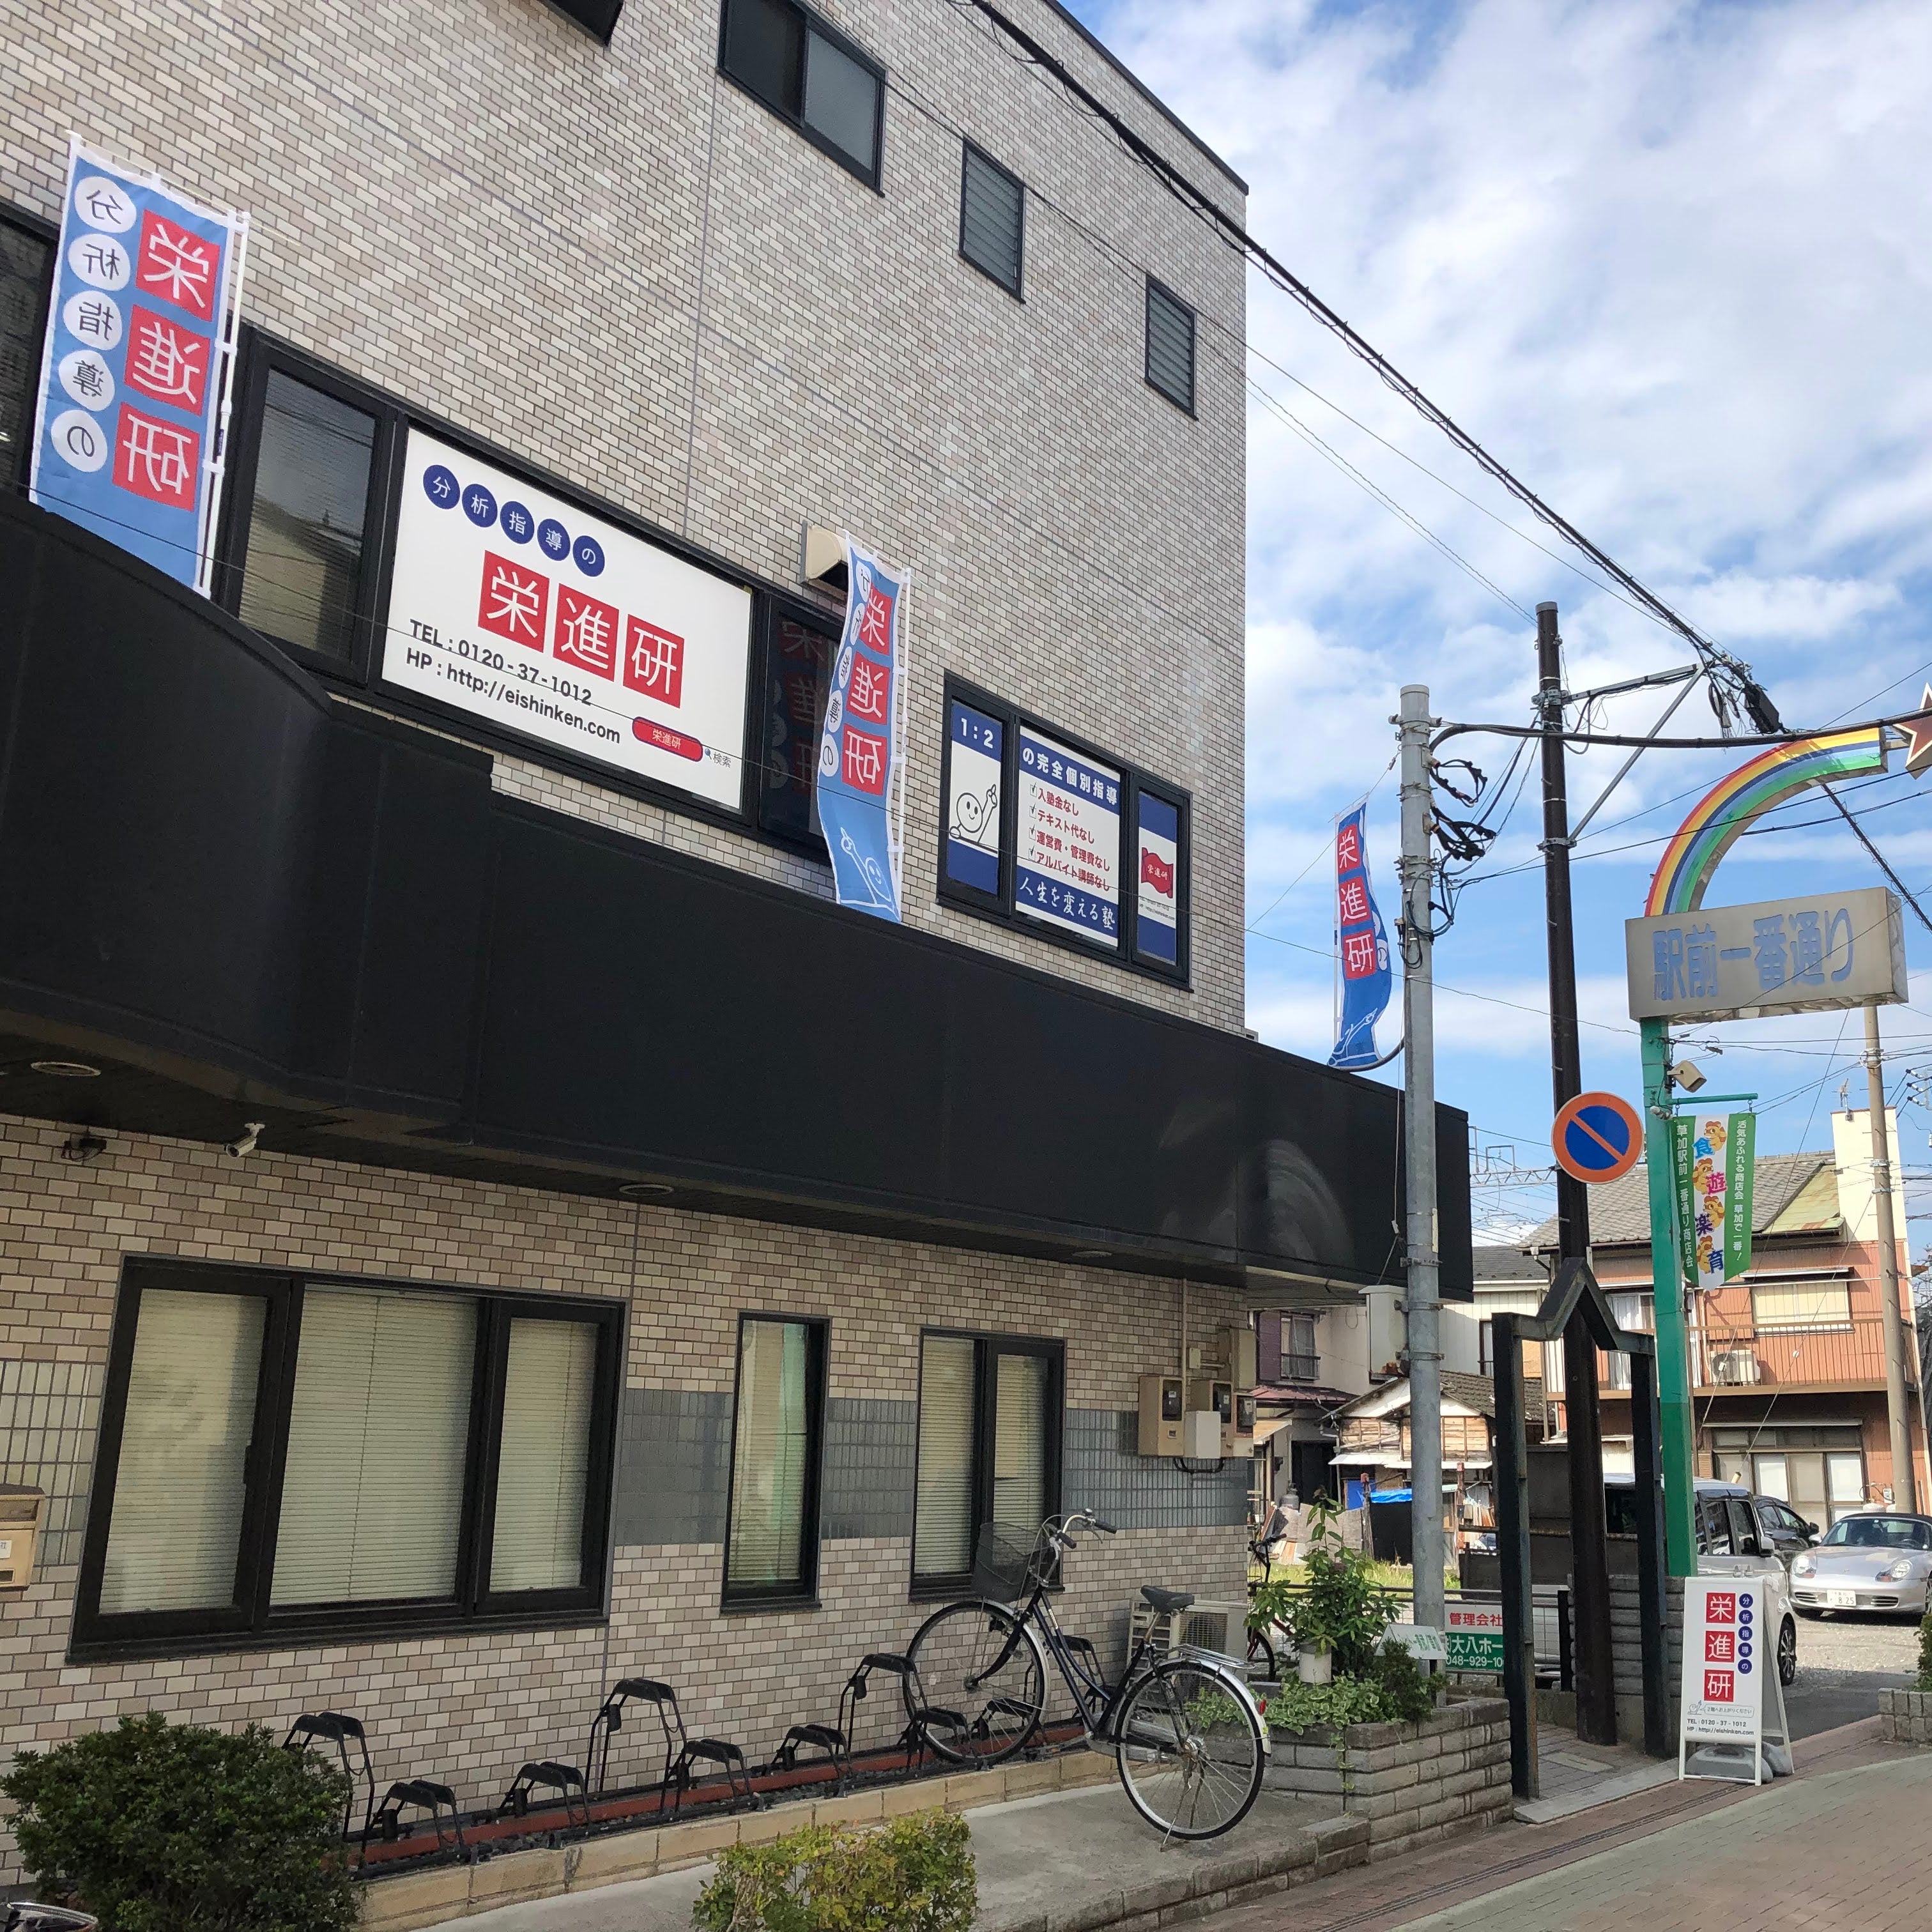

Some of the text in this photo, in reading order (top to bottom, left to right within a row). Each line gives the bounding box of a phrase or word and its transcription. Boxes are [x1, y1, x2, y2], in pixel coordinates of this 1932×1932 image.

[433, 475, 596, 564] 分析指導の
[486, 565, 677, 696] 栄進研
[652, 728, 681, 749] 栄進研
[712, 752, 732, 768] 検索
[1022, 747, 1117, 806] の完全個別指導
[1038, 788, 1079, 816] 入塾金なし
[1036, 830, 1110, 871] 運営費・管理費なし
[1038, 809, 1094, 845] テキスト代なし
[1036, 851, 1110, 891] アルバイト講師なし
[1019, 877, 1116, 930] 人生を変える塾
[1339, 829, 1374, 973] 栄進研
[1652, 908, 1853, 1001] 駅前一番通り
[1734, 1120, 1747, 1200] 活気あふれる商店会
[1449, 1613, 1503, 1627] 管理会社
[1706, 1595, 1733, 1698] 栄進研
[1741, 1597, 1750, 1671] 分析指導の
